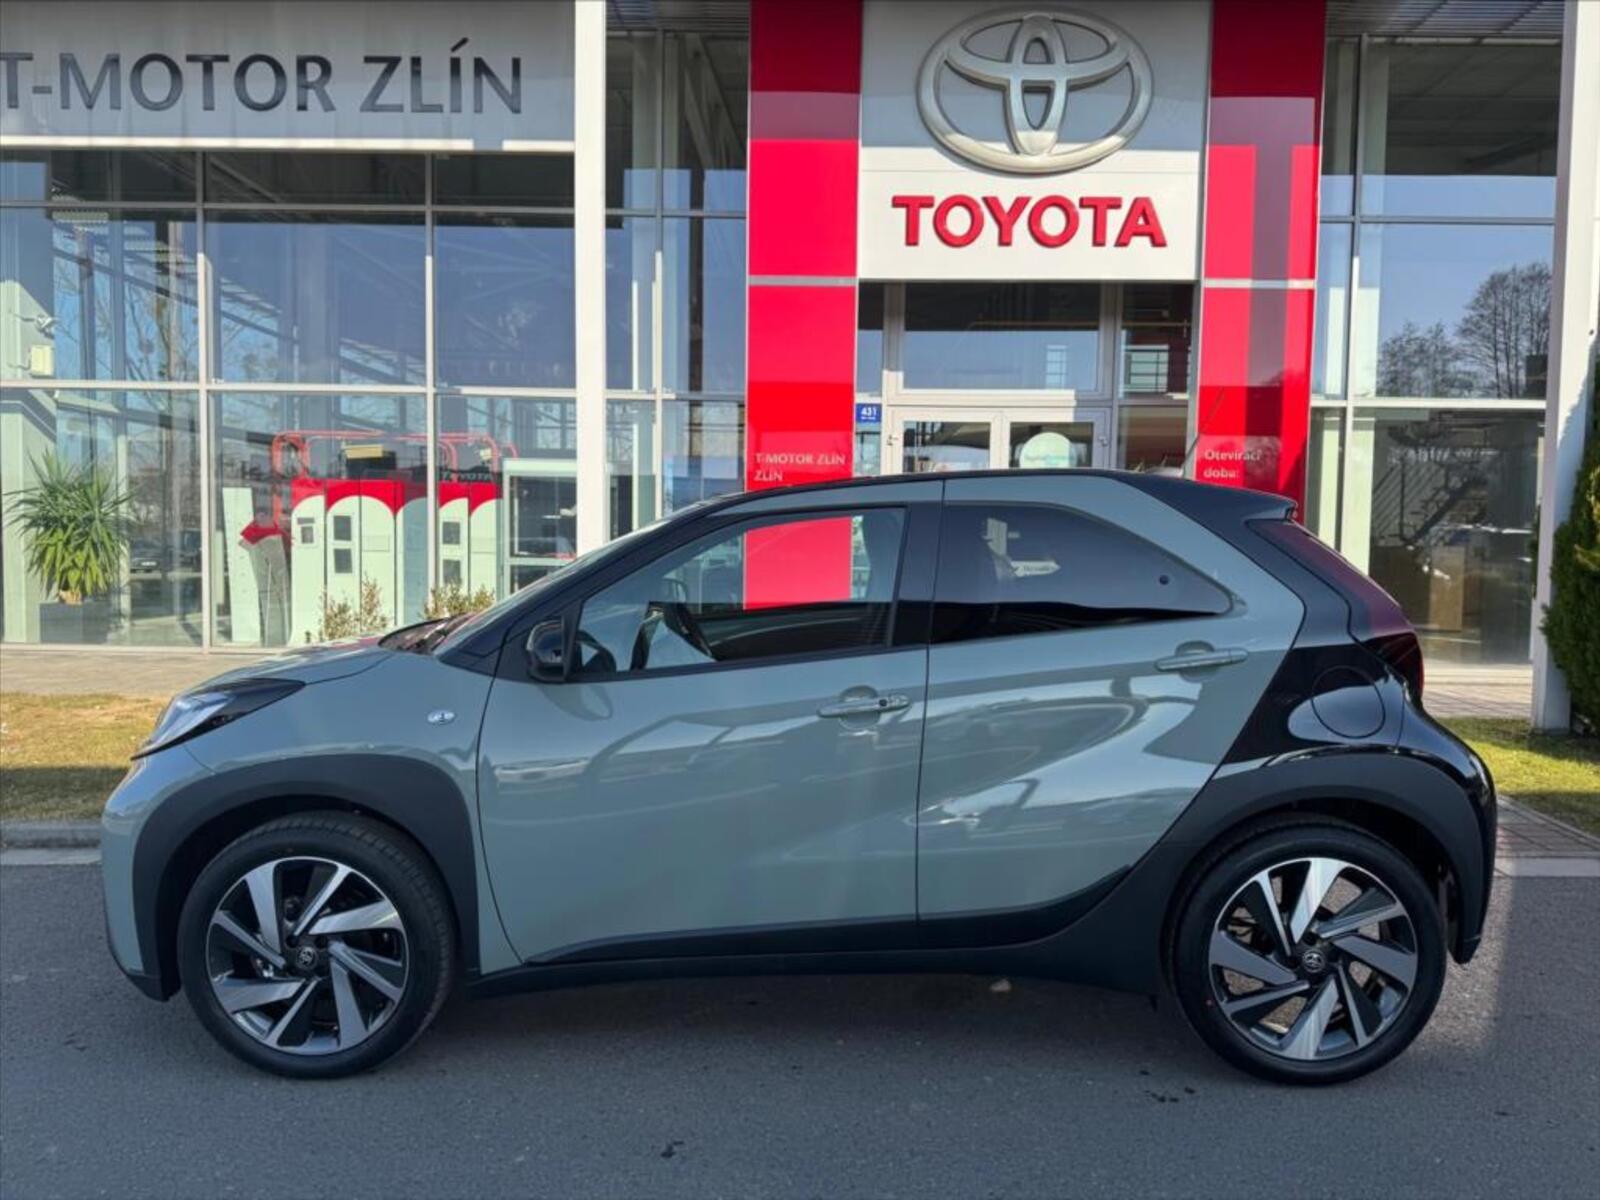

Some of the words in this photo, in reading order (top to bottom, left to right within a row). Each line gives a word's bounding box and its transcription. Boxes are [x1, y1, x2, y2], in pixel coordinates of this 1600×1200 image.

[0, 52, 337, 112] T-MOTOR
[360, 37, 522, 114] ZLÍN
[891, 194, 1168, 248] TOYOTA
[755, 453, 814, 464] T-MOTOR
